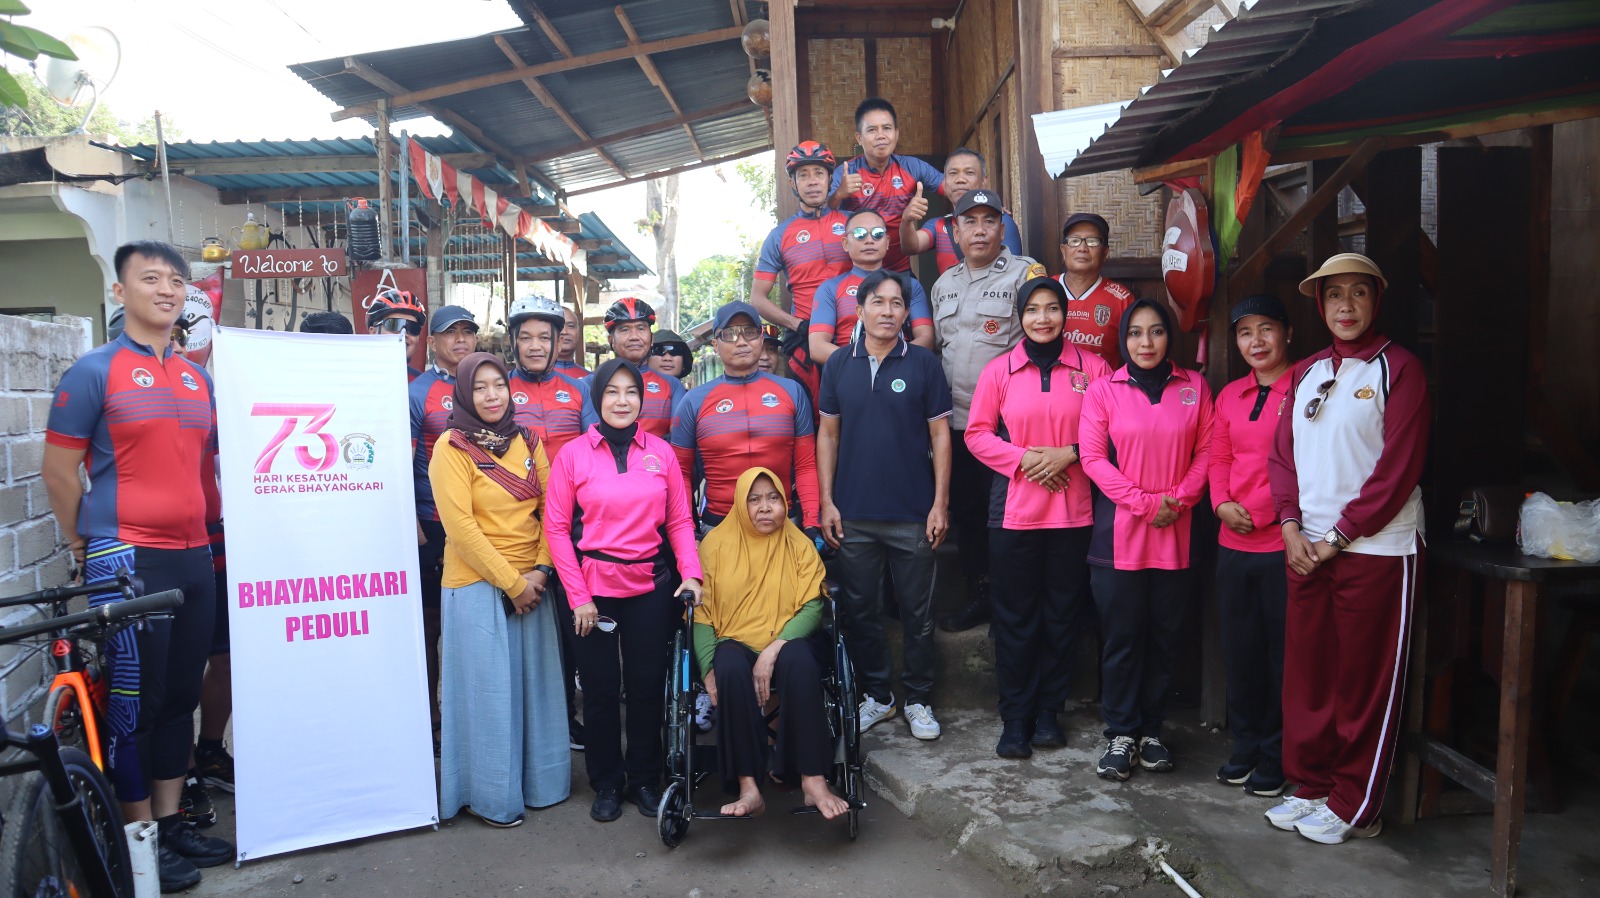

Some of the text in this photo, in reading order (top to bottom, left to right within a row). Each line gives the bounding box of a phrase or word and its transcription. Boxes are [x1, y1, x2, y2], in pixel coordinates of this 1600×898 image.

[239, 254, 338, 276] Welcome to
[982, 291, 1012, 300] POLRI
[250, 402, 339, 474] 73
[253, 473, 348, 484] HARI KESATUAN
[254, 481, 384, 495] GERAK BHAYANGKARI
[238, 570, 408, 608] BHAYANGKARI
[285, 609, 369, 643] PEDULI
